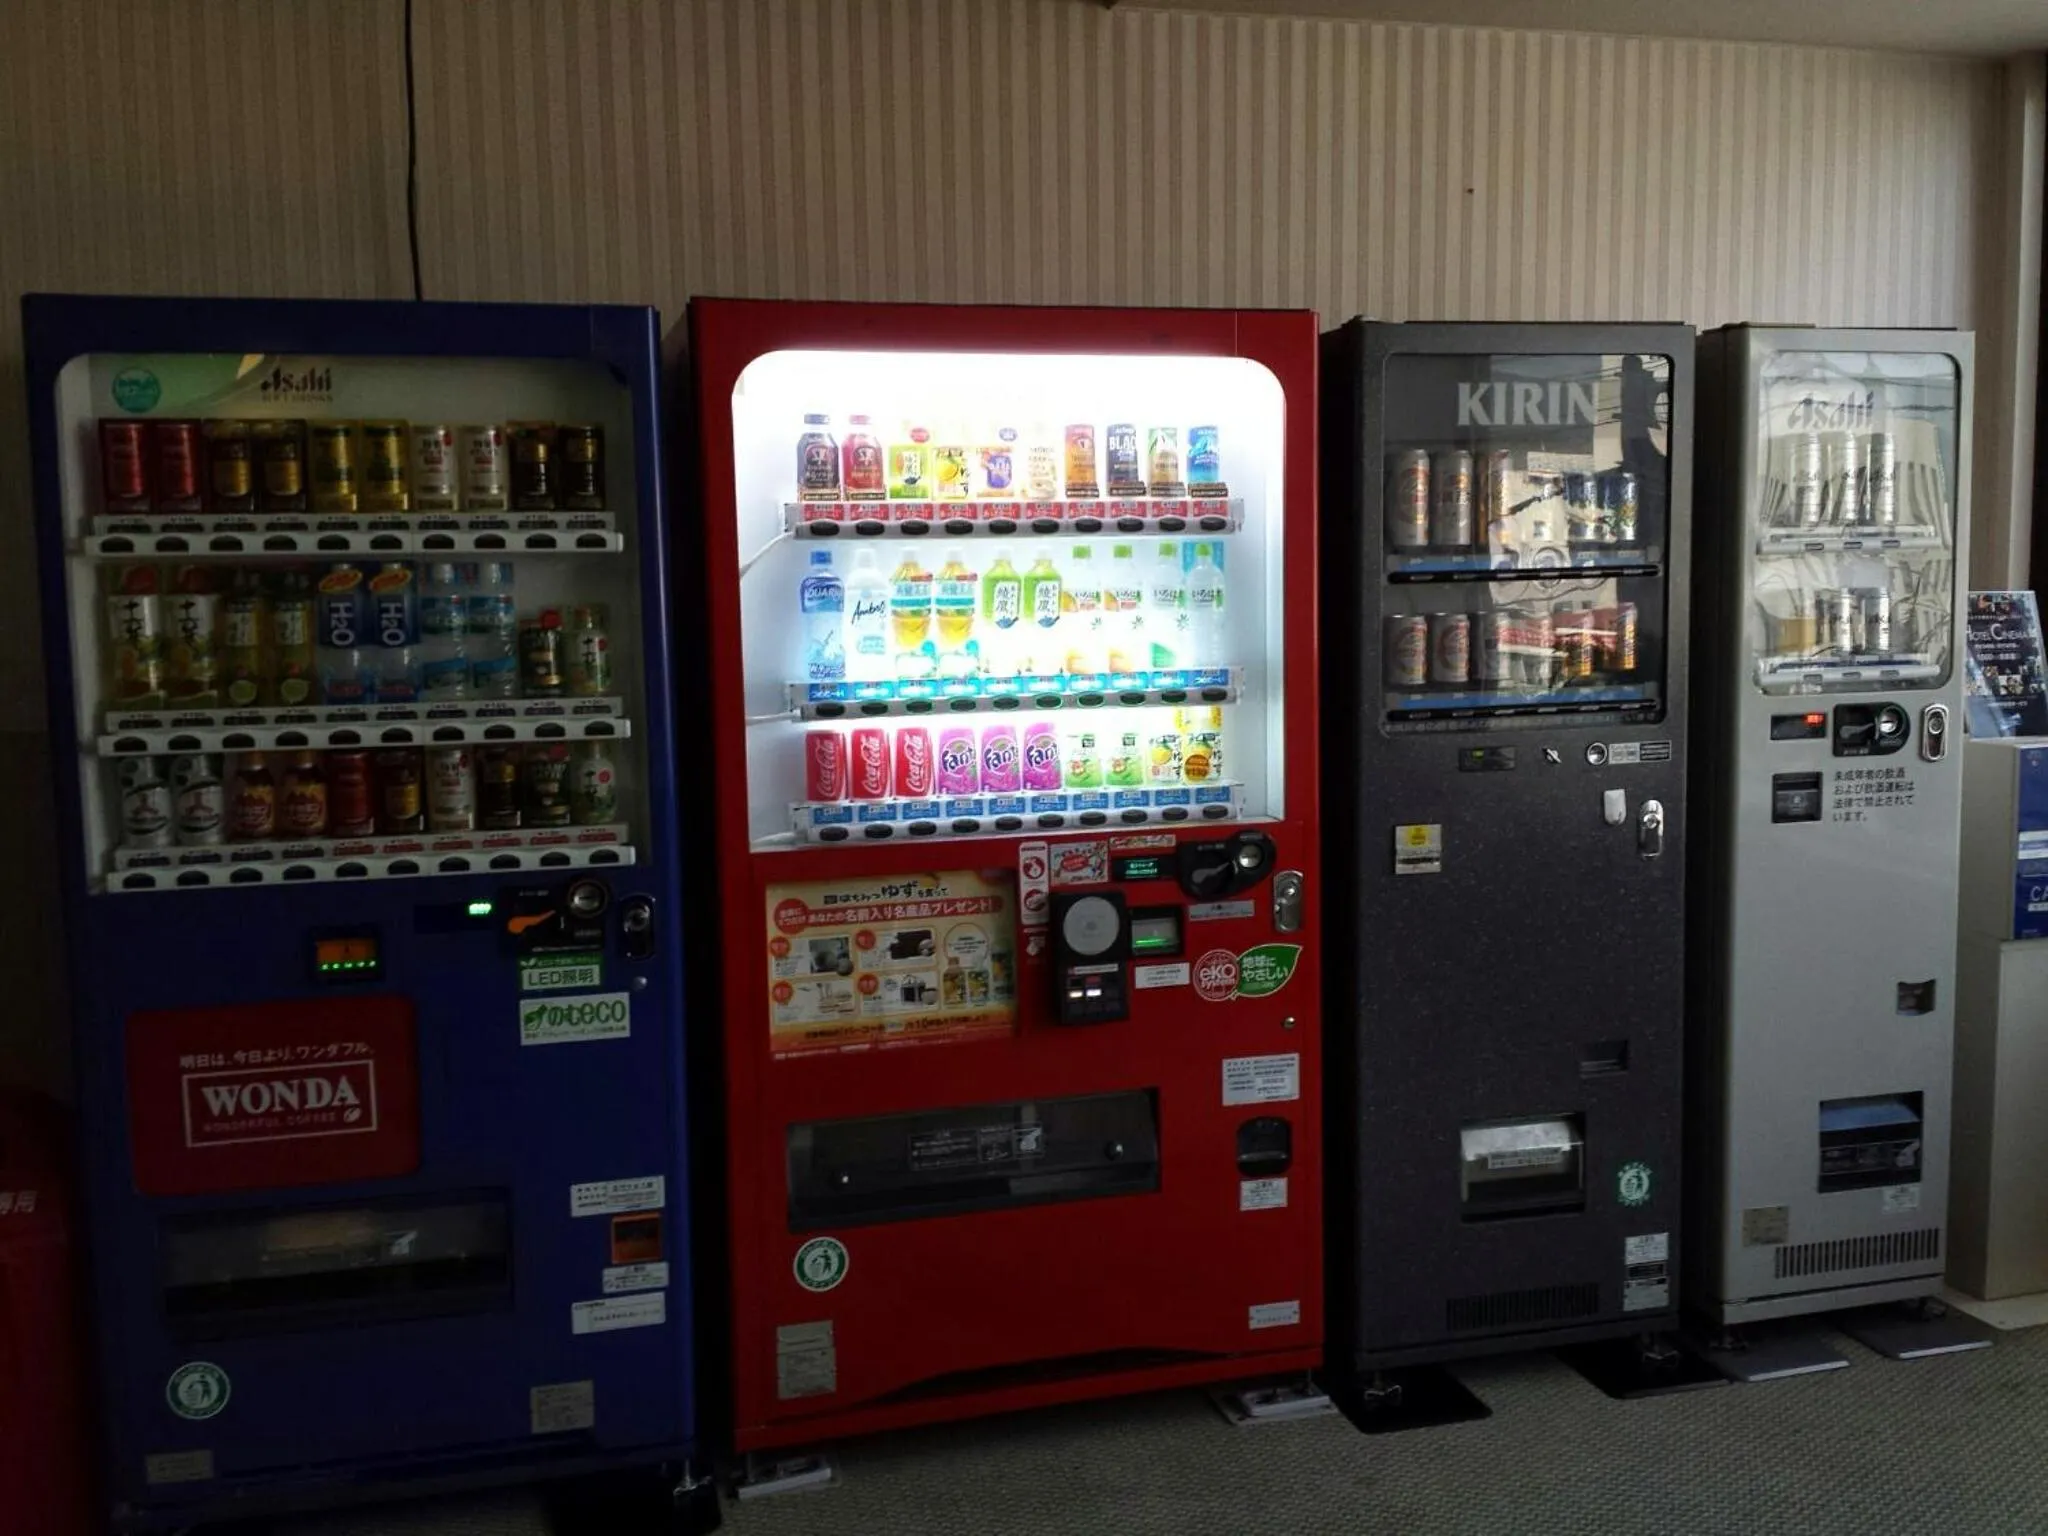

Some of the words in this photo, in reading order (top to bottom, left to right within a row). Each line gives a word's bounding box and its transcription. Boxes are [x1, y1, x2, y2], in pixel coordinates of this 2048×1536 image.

[261, 367, 332, 392] Asahi
[1456, 382, 1599, 426] KIRIN
[1788, 391, 1874, 430] Asahi
[330, 602, 355, 646] H2O
[379, 602, 406, 646] H2O
[1834, 767, 1906, 783] 未成年者の飲酒
[1834, 781, 1916, 797] および飲酒運転は
[1833, 795, 1914, 811] 法律で禁止されて
[528, 967, 594, 987] LED照明
[200, 1075, 361, 1118] WONDA
